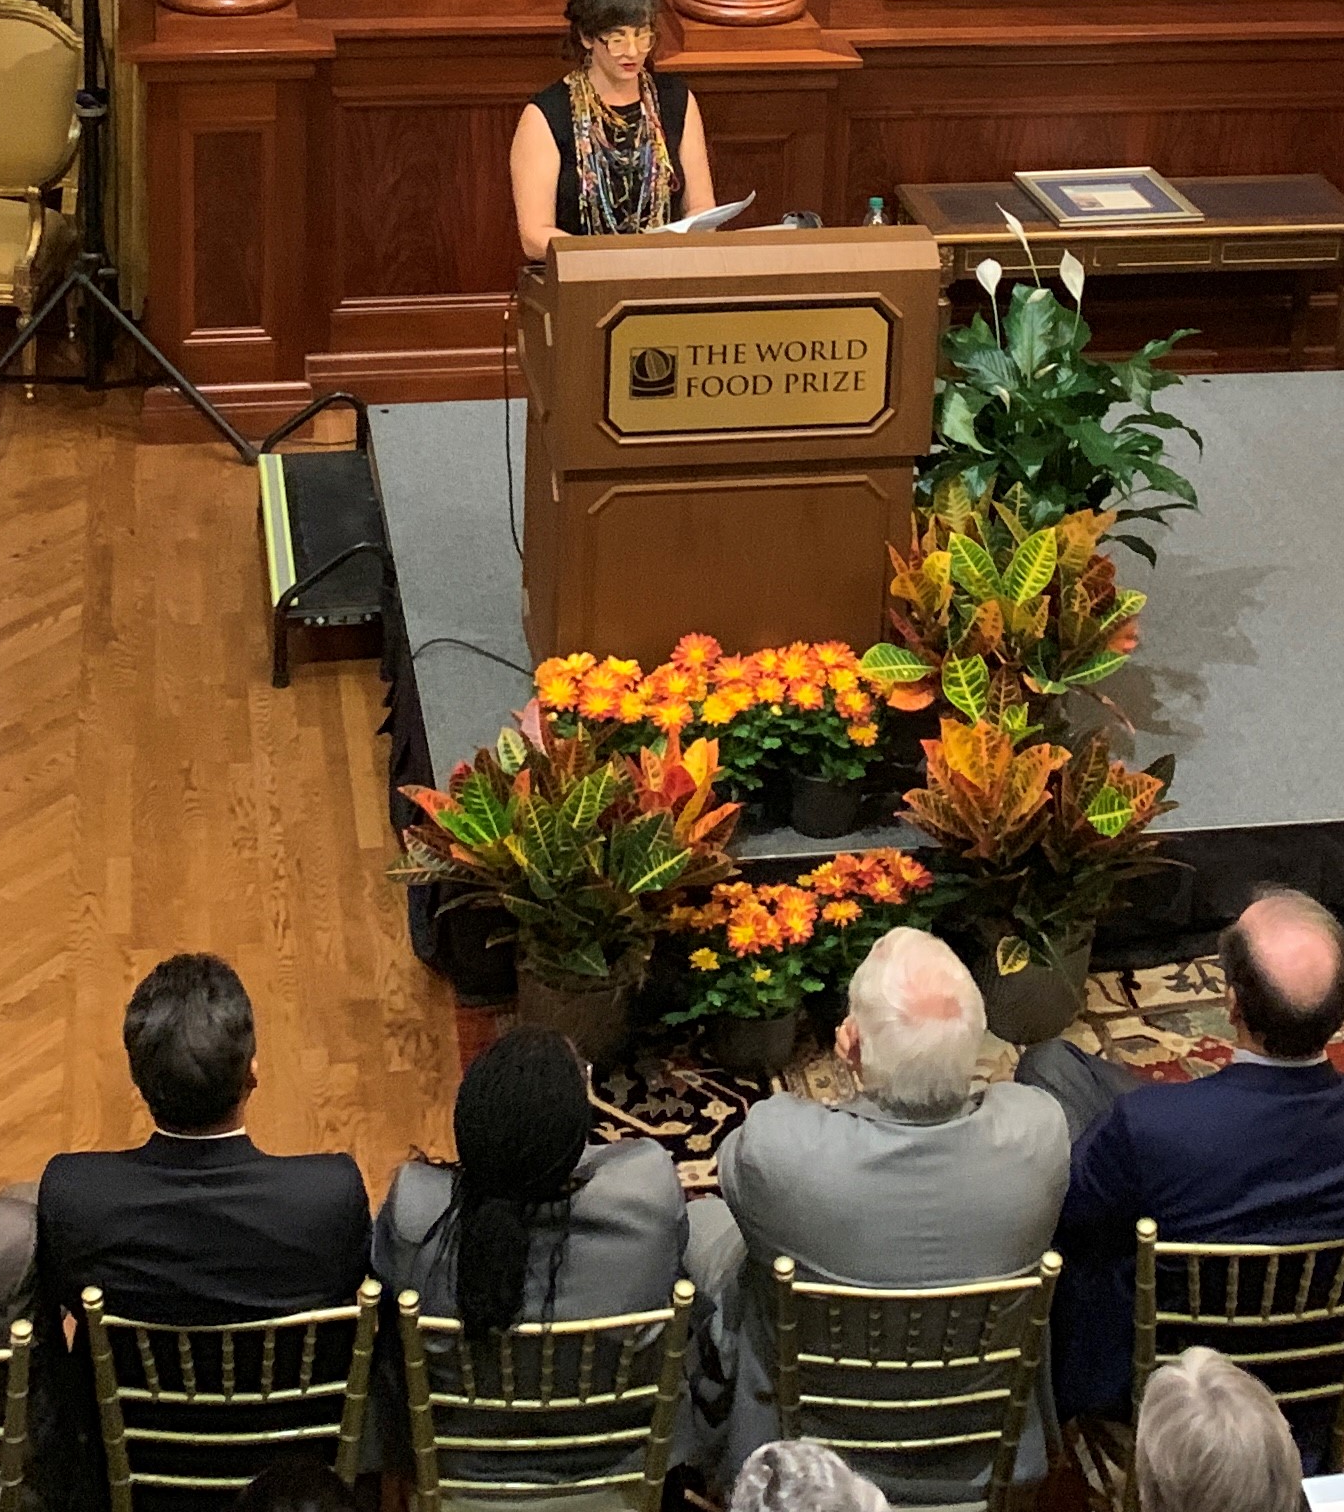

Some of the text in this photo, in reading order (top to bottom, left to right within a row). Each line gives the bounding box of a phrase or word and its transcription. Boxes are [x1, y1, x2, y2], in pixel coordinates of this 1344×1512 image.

[686, 339, 867, 366] THE WORLD
[686, 371, 866, 398] FOOD PRIZE
